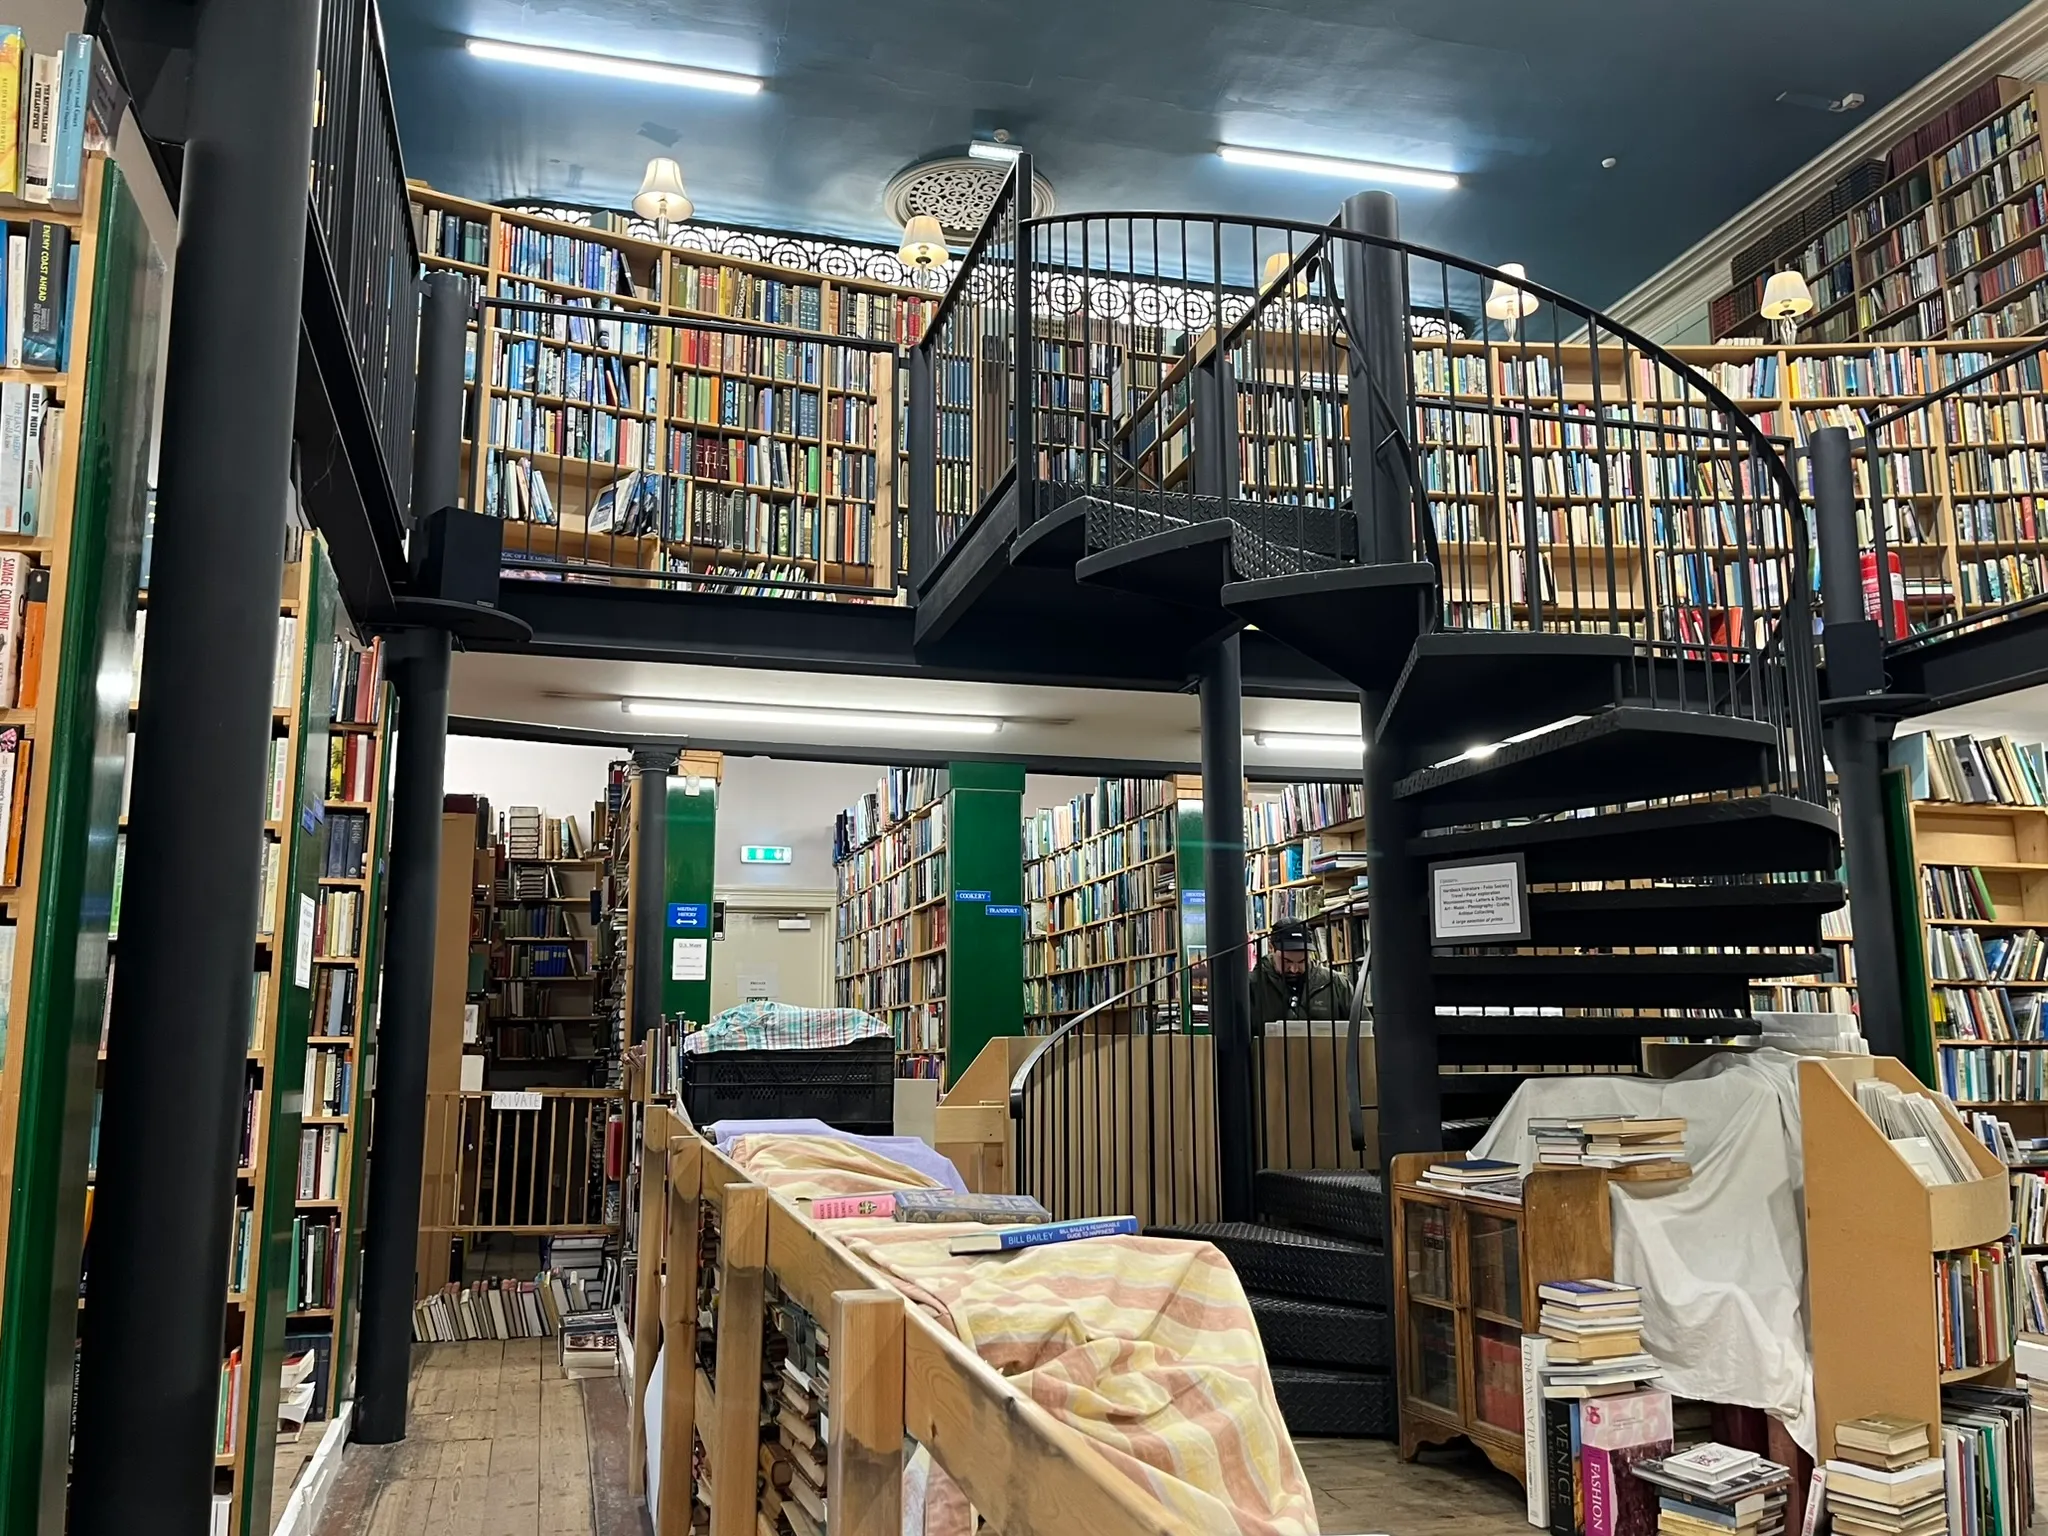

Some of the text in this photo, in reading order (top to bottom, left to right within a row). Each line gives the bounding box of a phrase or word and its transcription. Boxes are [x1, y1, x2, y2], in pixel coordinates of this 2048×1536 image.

[75, 69, 84, 94] Country
[33, 98, 41, 113] LAST
[72, 109, 81, 127] Court
[38, 224, 51, 301] ENEMY COAST AHEAD
[13, 417, 22, 433] LAST
[29, 392, 40, 437] BRIT NOIR
[0, 558, 15, 631] SAVAGE CONTINENT
[493, 1094, 540, 1107] PRIVATE
[1089, 1228, 1115, 1237] HAPPINESS
[1090, 1221, 1120, 1231] REMARKABLE
[1008, 1231, 1054, 1245] BILL BAILEY
[1523, 1343, 1536, 1450] ATLAS WORLD
[1555, 1423, 1571, 1506] VENICE
[1590, 1462, 1603, 1531] FASHION
